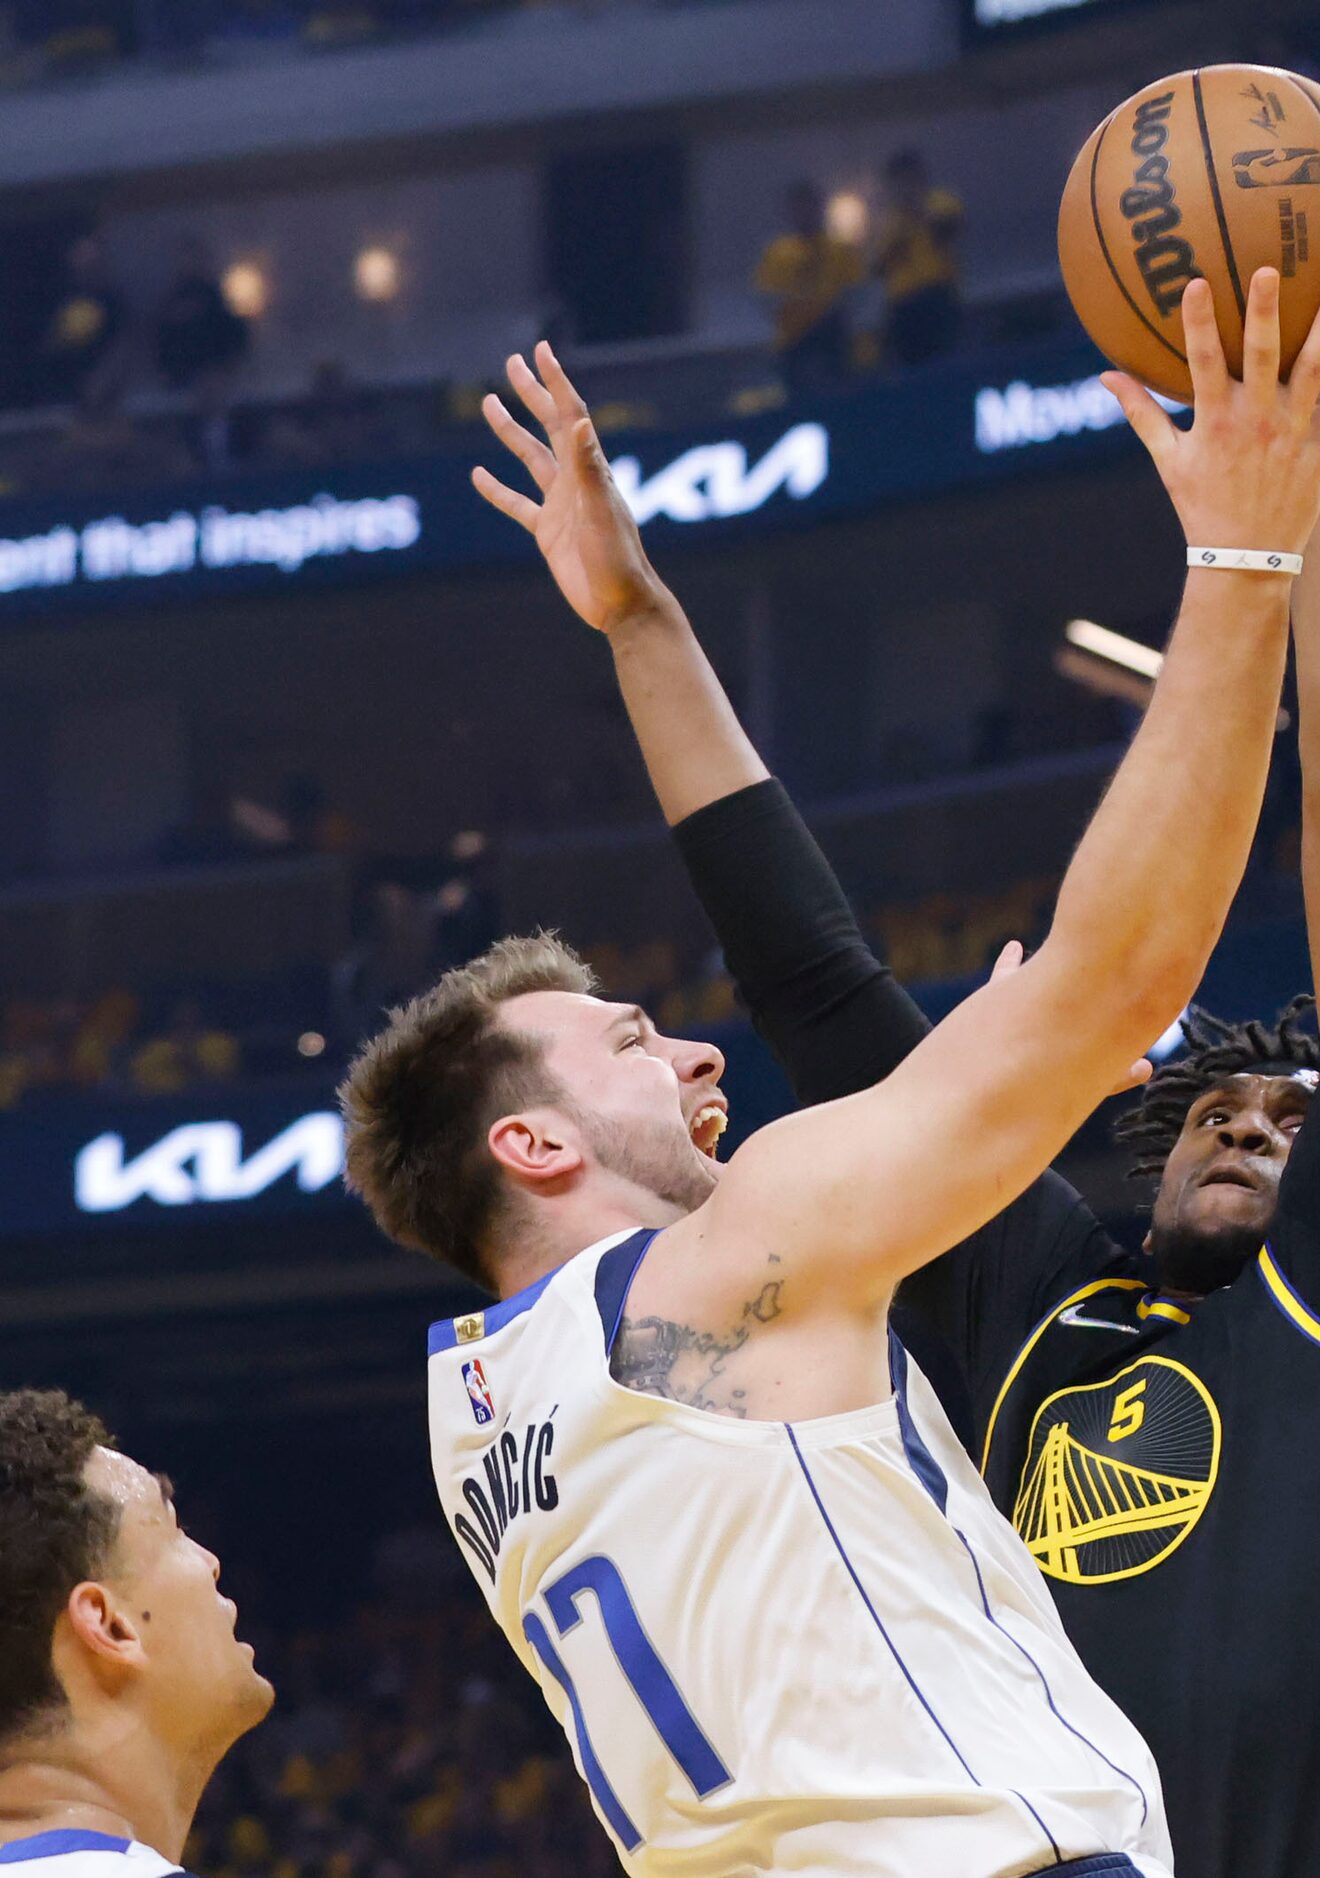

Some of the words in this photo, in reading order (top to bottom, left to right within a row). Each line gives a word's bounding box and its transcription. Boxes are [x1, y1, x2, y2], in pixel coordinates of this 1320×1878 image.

[1119, 91, 1205, 318] Wilson
[82, 514, 197, 581] that
[201, 493, 421, 573] inspires
[1107, 1378, 1147, 1443] 5
